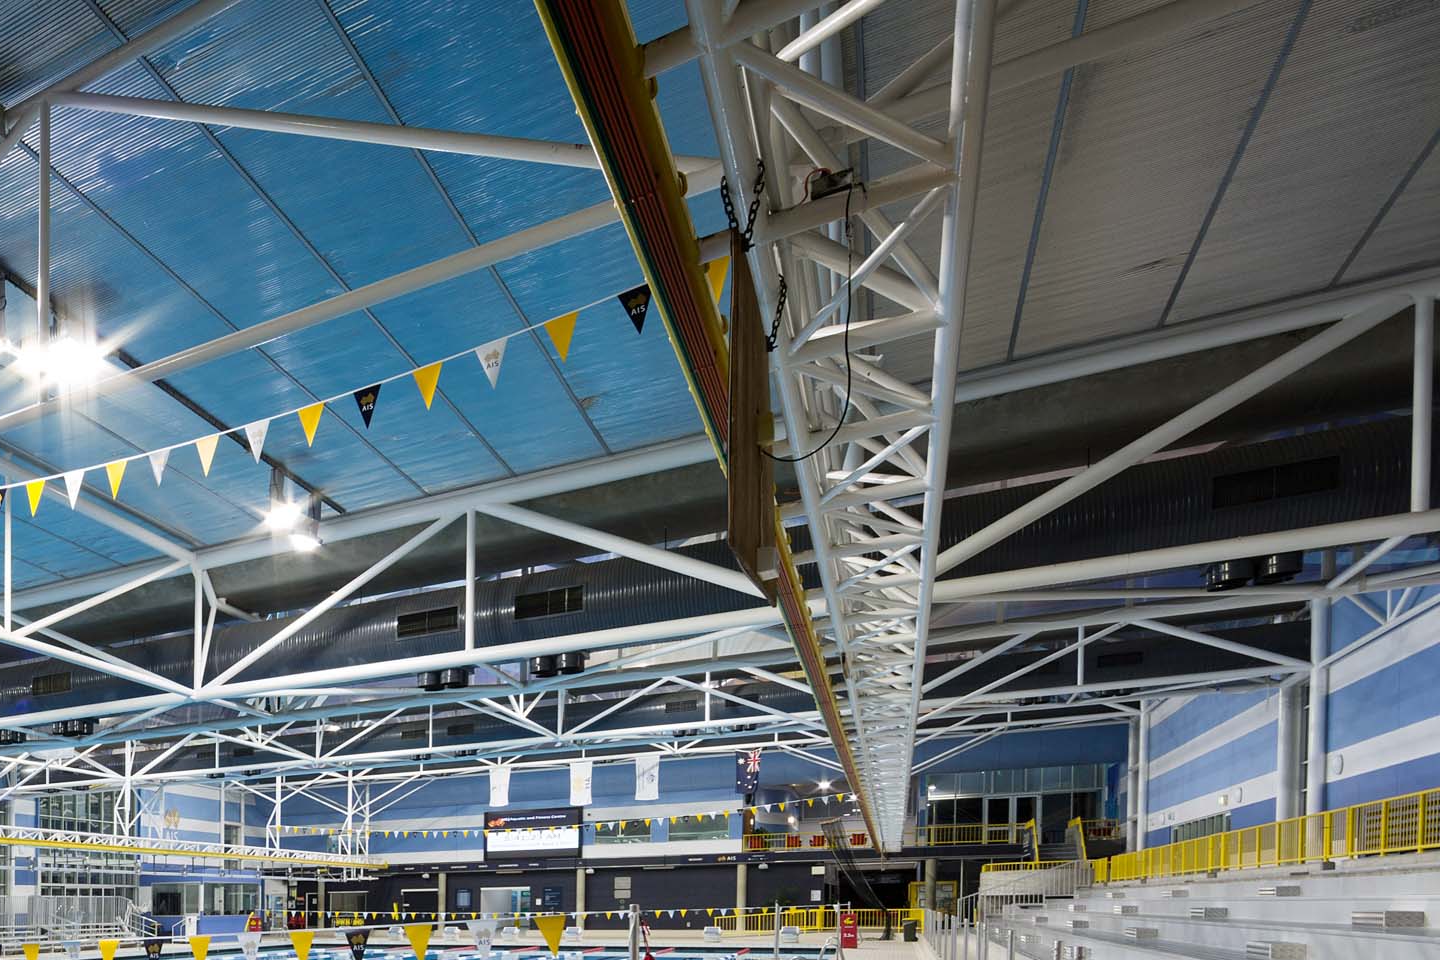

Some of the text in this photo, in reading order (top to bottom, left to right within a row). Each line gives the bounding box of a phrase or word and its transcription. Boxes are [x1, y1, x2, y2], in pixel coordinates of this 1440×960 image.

[631, 304, 646, 316] AIS
[486, 360, 500, 370] AIS
[361, 403, 374, 413] AIS
